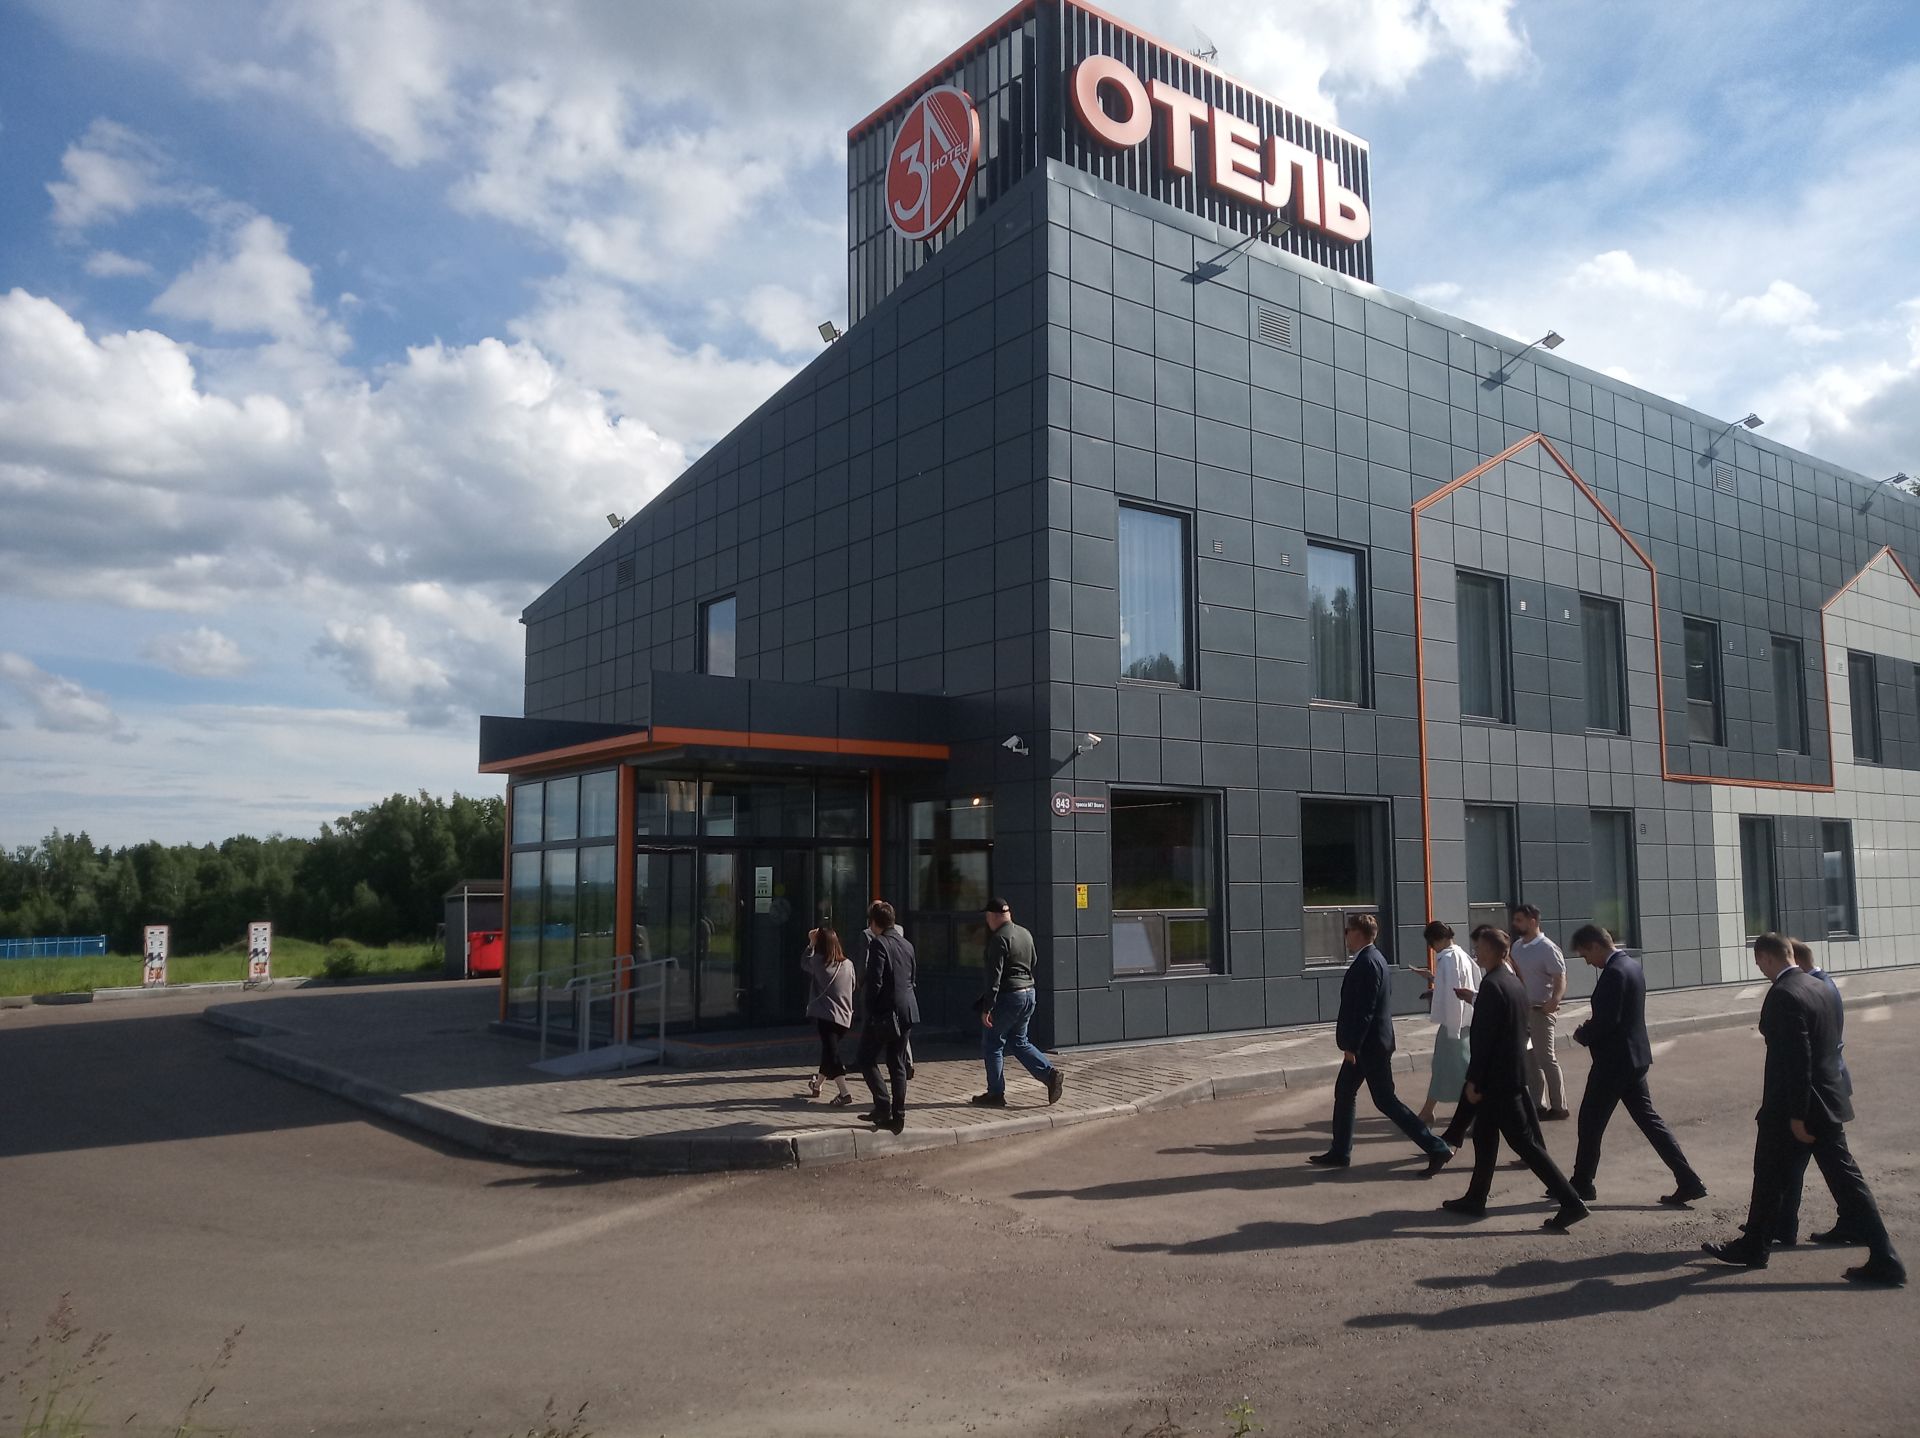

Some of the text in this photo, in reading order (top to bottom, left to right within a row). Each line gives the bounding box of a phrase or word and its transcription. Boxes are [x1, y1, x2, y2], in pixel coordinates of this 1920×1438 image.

[931, 142, 968, 173] HOTEL
[1072, 54, 1371, 242] ОТЕЛЬ
[1056, 798, 1070, 808] 843
